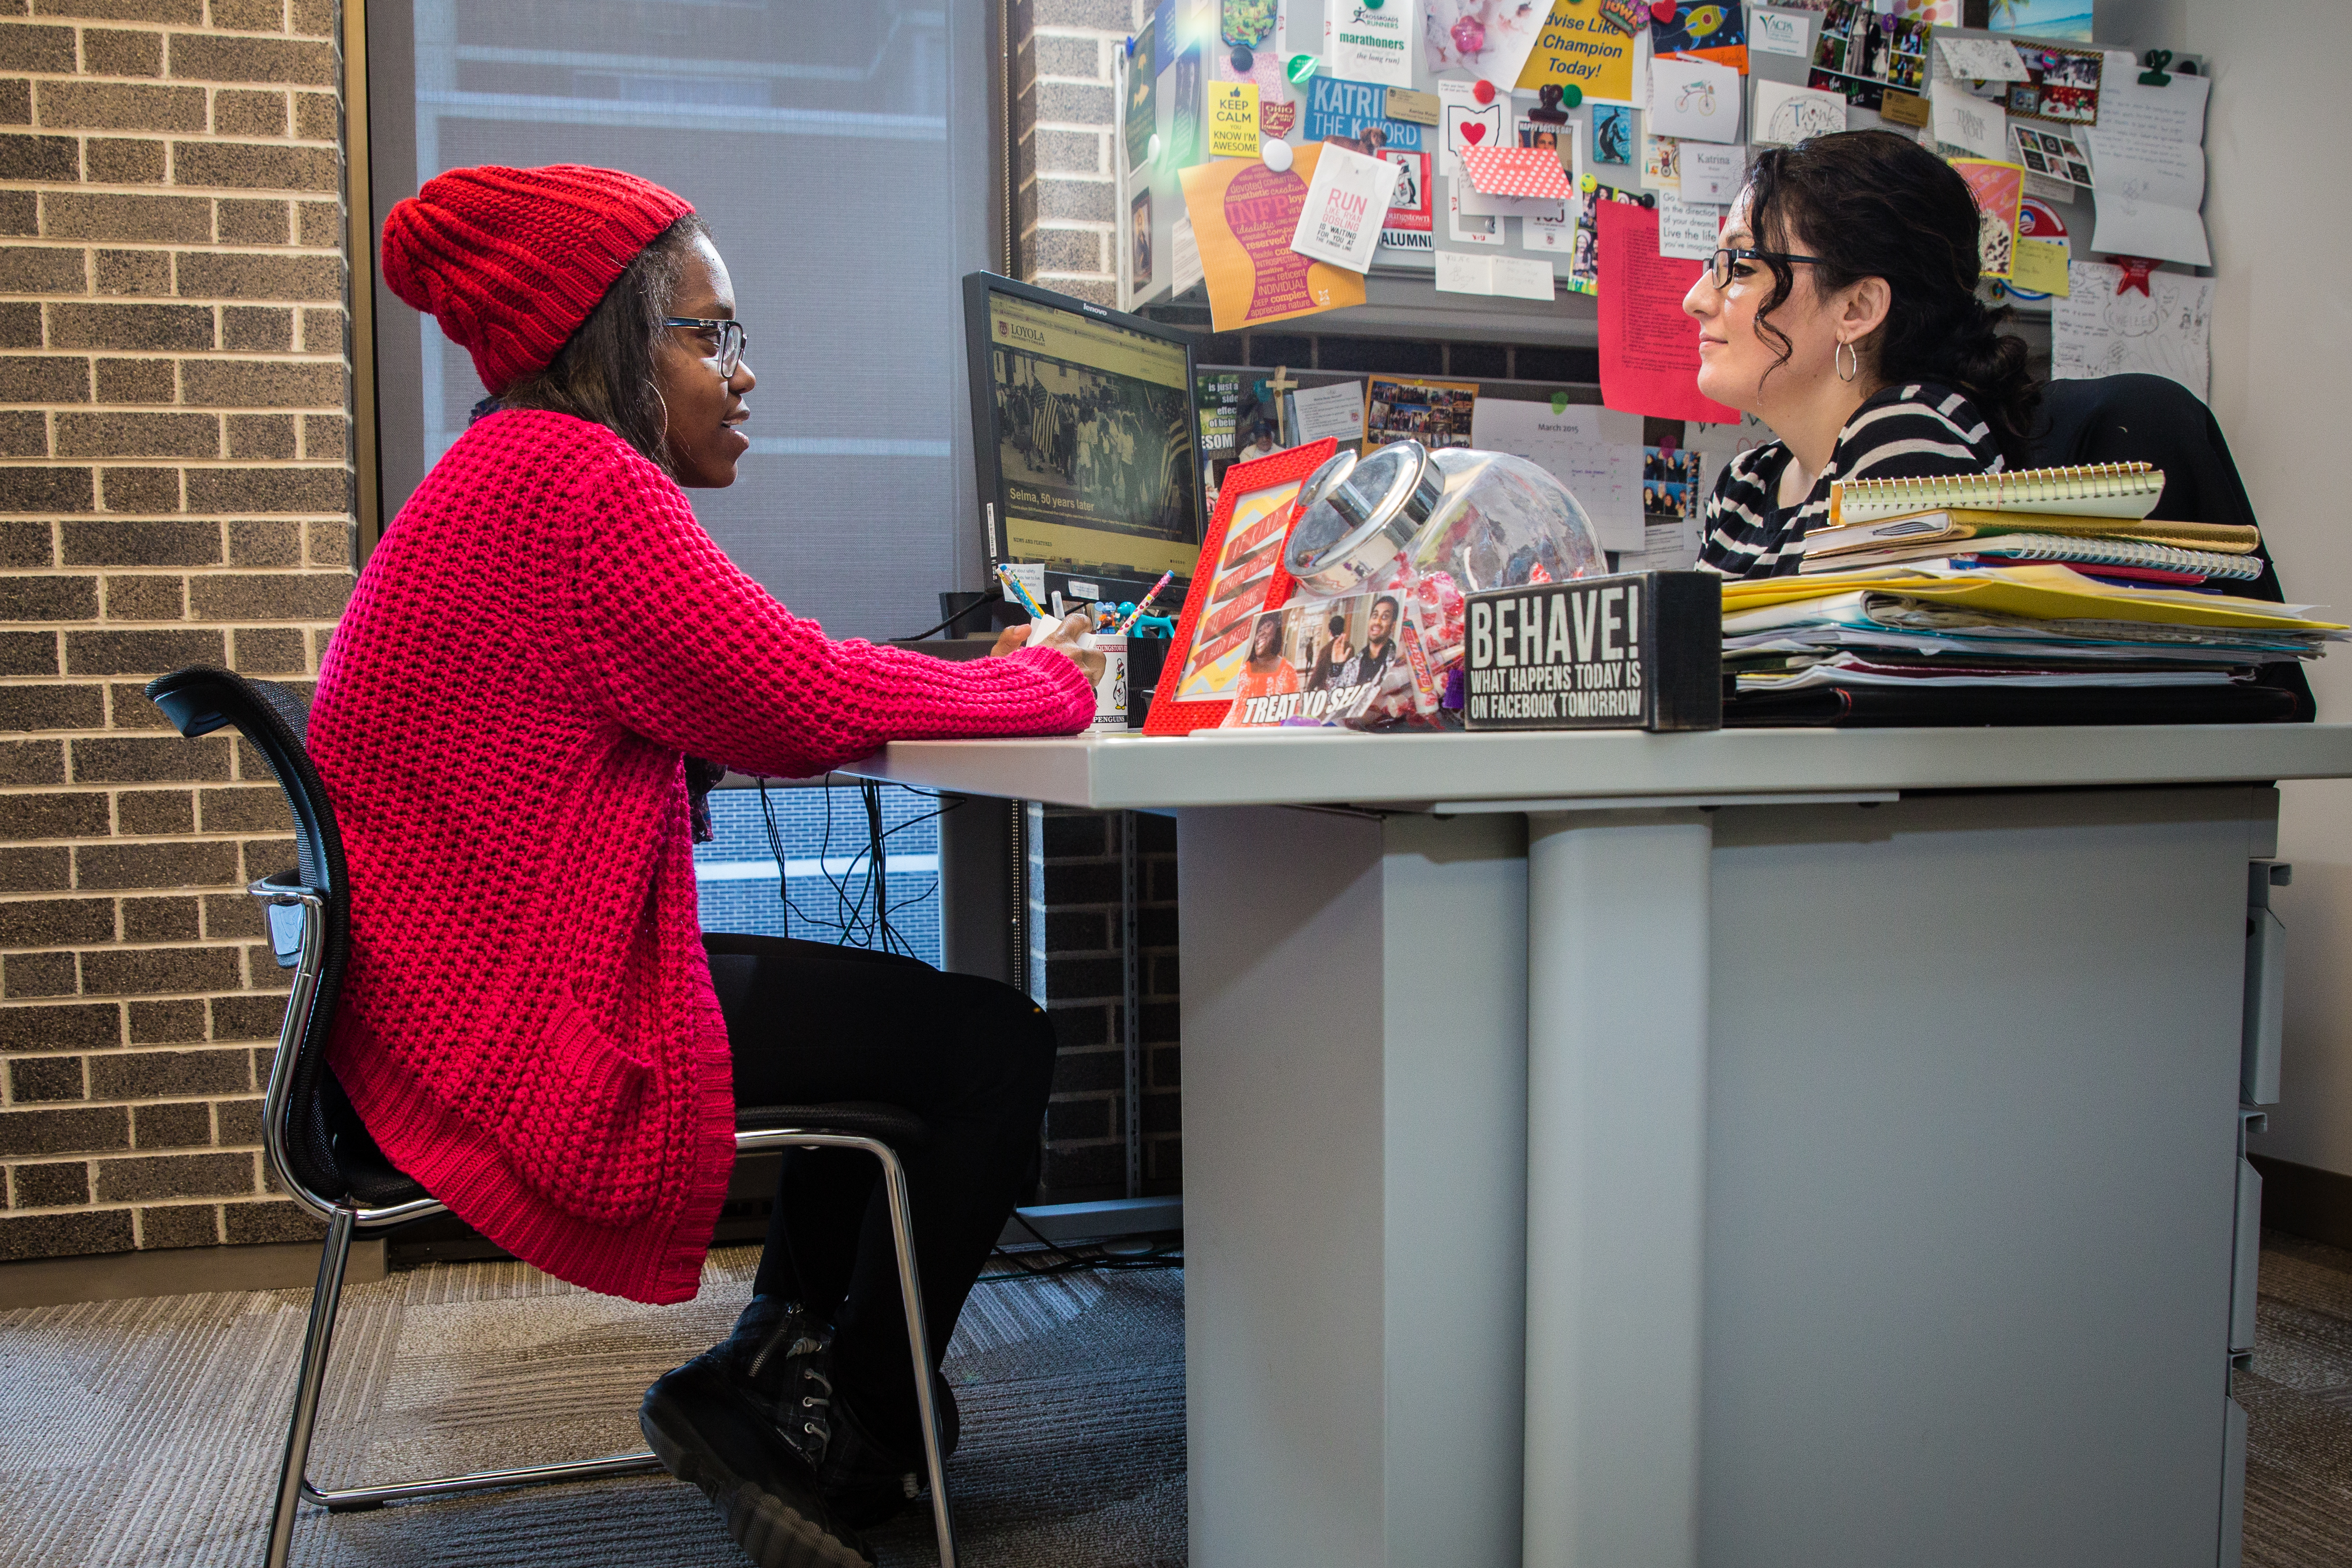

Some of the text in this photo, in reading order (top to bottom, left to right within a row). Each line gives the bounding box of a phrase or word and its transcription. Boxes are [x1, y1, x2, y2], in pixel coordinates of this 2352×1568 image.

[1366, 20, 1398, 29] RUNNERS
[1544, 12, 1621, 35] dvise Like
[1340, 32, 1404, 50] marathoners
[1543, 33, 1623, 59] Champion
[1369, 53, 1383, 63] long
[1549, 57, 1602, 80] Today!
[1220, 99, 1248, 110] KEEP
[1217, 111, 1251, 123] CALM
[1788, 101, 1836, 127] Thank
[1313, 112, 1345, 137] THE
[1351, 117, 1361, 139] K
[1519, 122, 1538, 132] HAPPY
[1561, 126, 1572, 134] DAY
[1214, 131, 1242, 140] KNOW
[1213, 141, 1258, 152] AWESOME
[1697, 153, 1730, 165] Katrina
[1225, 183, 1305, 202] empathetic creative
[1230, 175, 1298, 194] devoted COMMITTED
[1328, 188, 1367, 215] RUN
[1664, 192, 1675, 202] Go
[1226, 195, 1289, 225] INFP
[1325, 206, 1362, 223] LIKE RYAN
[1386, 213, 1429, 222] oungstown
[1673, 205, 1683, 214] the
[1685, 206, 1716, 217] direction
[1237, 221, 1275, 235] idealistic
[1322, 214, 1359, 232] GOSLING
[1331, 226, 1356, 240] WAITING
[1381, 231, 1432, 248] ALUMNI
[1664, 227, 1716, 242] Live the life
[1245, 235, 1286, 250] reserved
[1326, 240, 1340, 248] FINISH
[1256, 253, 1300, 268] INTROSPECTIVE
[1257, 267, 1284, 276] sensitive
[1277, 268, 1306, 281] reticent
[1258, 278, 1306, 296] INDIVIDUAL
[1254, 298, 1269, 308] DEEP
[1270, 291, 1307, 304] complex
[1083, 303, 1107, 316] lenovo
[1251, 303, 1287, 318] appreciate
[1288, 300, 1310, 309] nature
[1011, 324, 1044, 341] LOYOLA
[1217, 382, 1233, 393] just
[1222, 394, 1238, 403] side
[1217, 406, 1237, 416] effec
[1210, 419, 1236, 428] of bein
[1538, 423, 1562, 432] March
[1202, 433, 1235, 450] ESOM
[1009, 488, 1094, 512] Selma, 50 years later
[1232, 534, 1246, 559] BE
[1219, 549, 1276, 595] EVERYONE YOU MEET
[1211, 588, 1260, 632] IS FIGHTING
[1471, 585, 1639, 669] BEHAVE!
[1200, 625, 1250, 666] A HARD BATTLE
[1403, 627, 1431, 686] SMARTIES
[1470, 661, 1641, 694] WHAT HAPPENS TODAY IS
[1242, 692, 1301, 724] TREAT
[1303, 689, 1328, 717] YO
[1471, 689, 1641, 719] ON FACEBOOK TOMORROW
